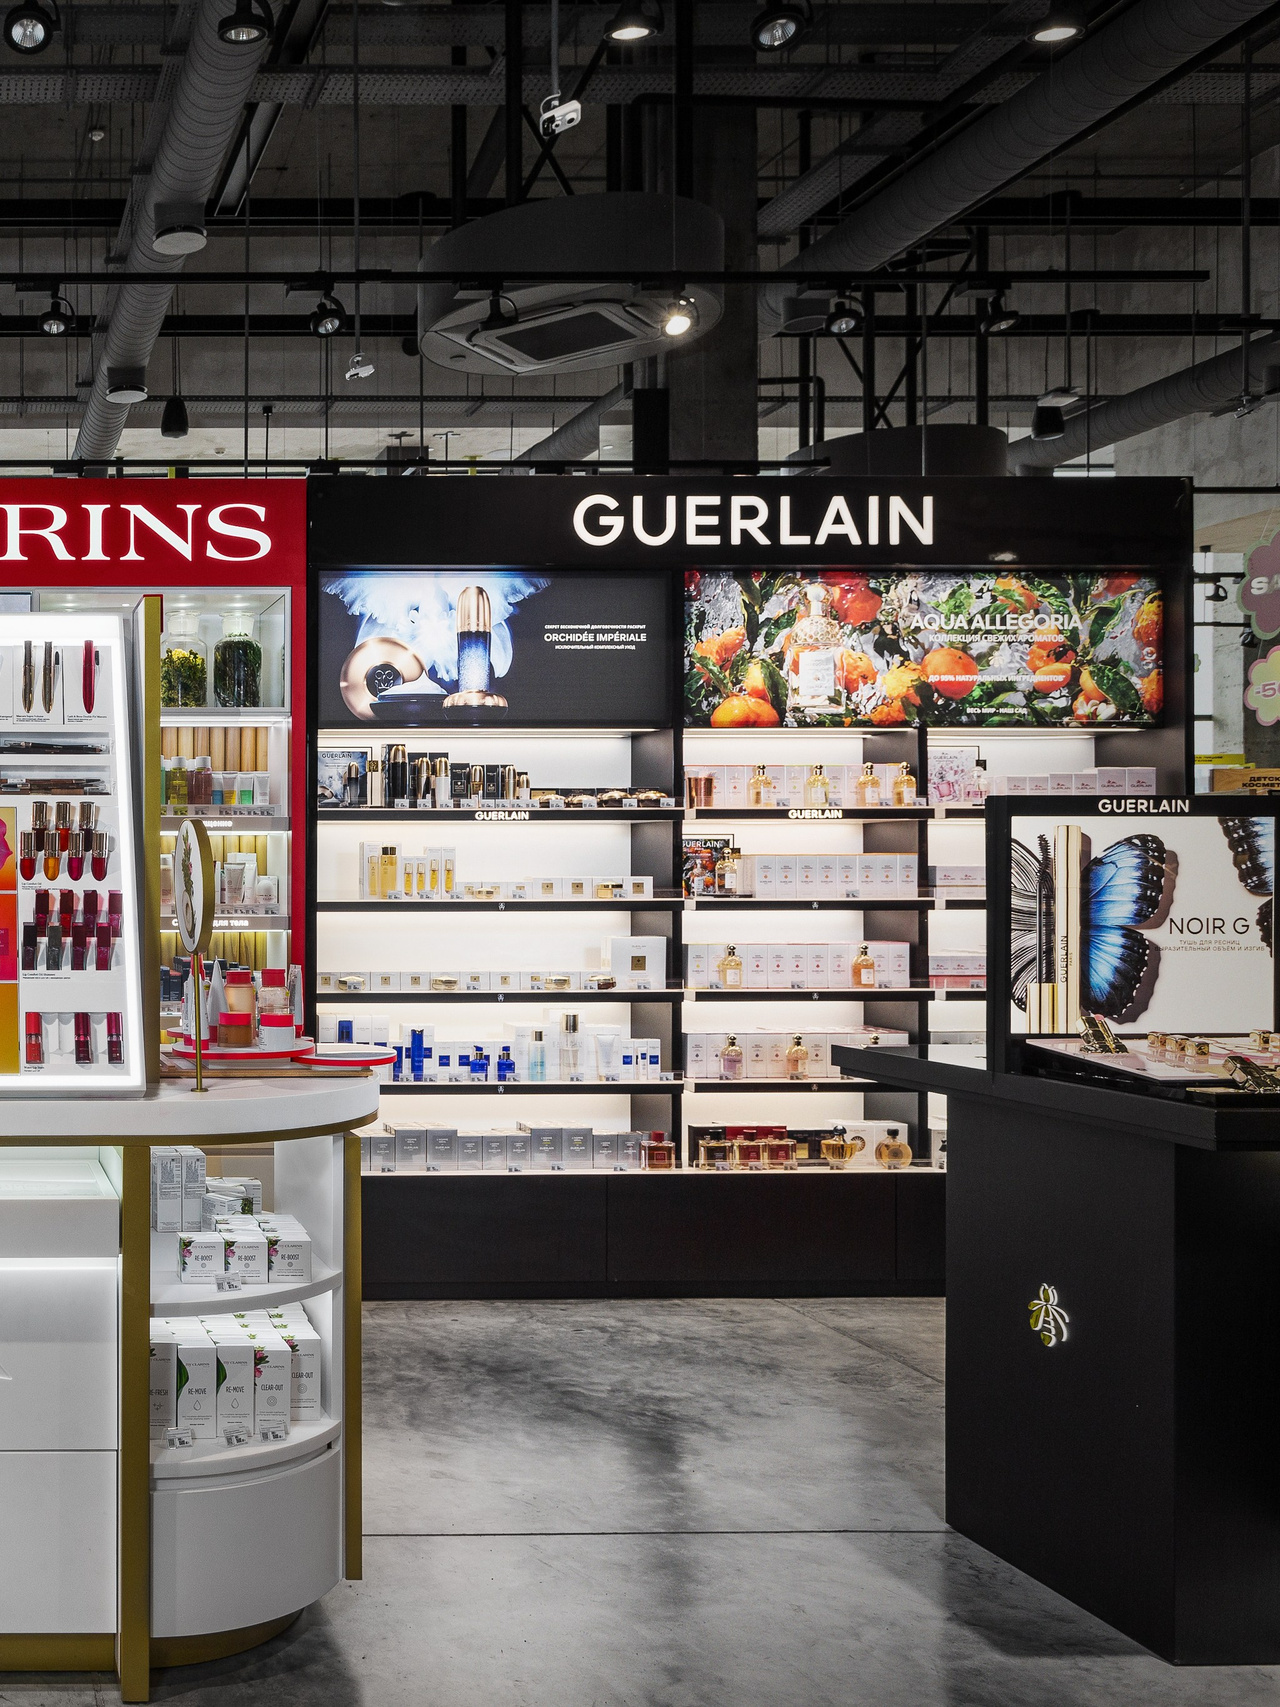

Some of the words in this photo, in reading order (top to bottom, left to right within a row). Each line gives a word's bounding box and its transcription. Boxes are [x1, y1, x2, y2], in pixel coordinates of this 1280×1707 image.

[573, 493, 934, 547] GUERLAIN
[910, 614, 969, 630] AQUA
[971, 614, 1083, 630] ALLEGORIA
[543, 631, 595, 642] ORCHIDÉE
[596, 631, 647, 642] IMPÉRIALE
[929, 635, 980, 643] КОЛЛЕКЦИЯ
[982, 635, 1016, 643] СВЕЖИХ
[1017, 635, 1064, 643] АРОМАТОВ
[1098, 799, 1190, 813] GUERLAIN
[475, 811, 530, 821] GUERLAIN
[788, 809, 843, 819] GUERLAIN
[202, 820, 233, 829] щение
[1169, 917, 1225, 934] NOIR
[1232, 917, 1249, 934] G
[1059, 935, 1068, 983] GUERLAIN
